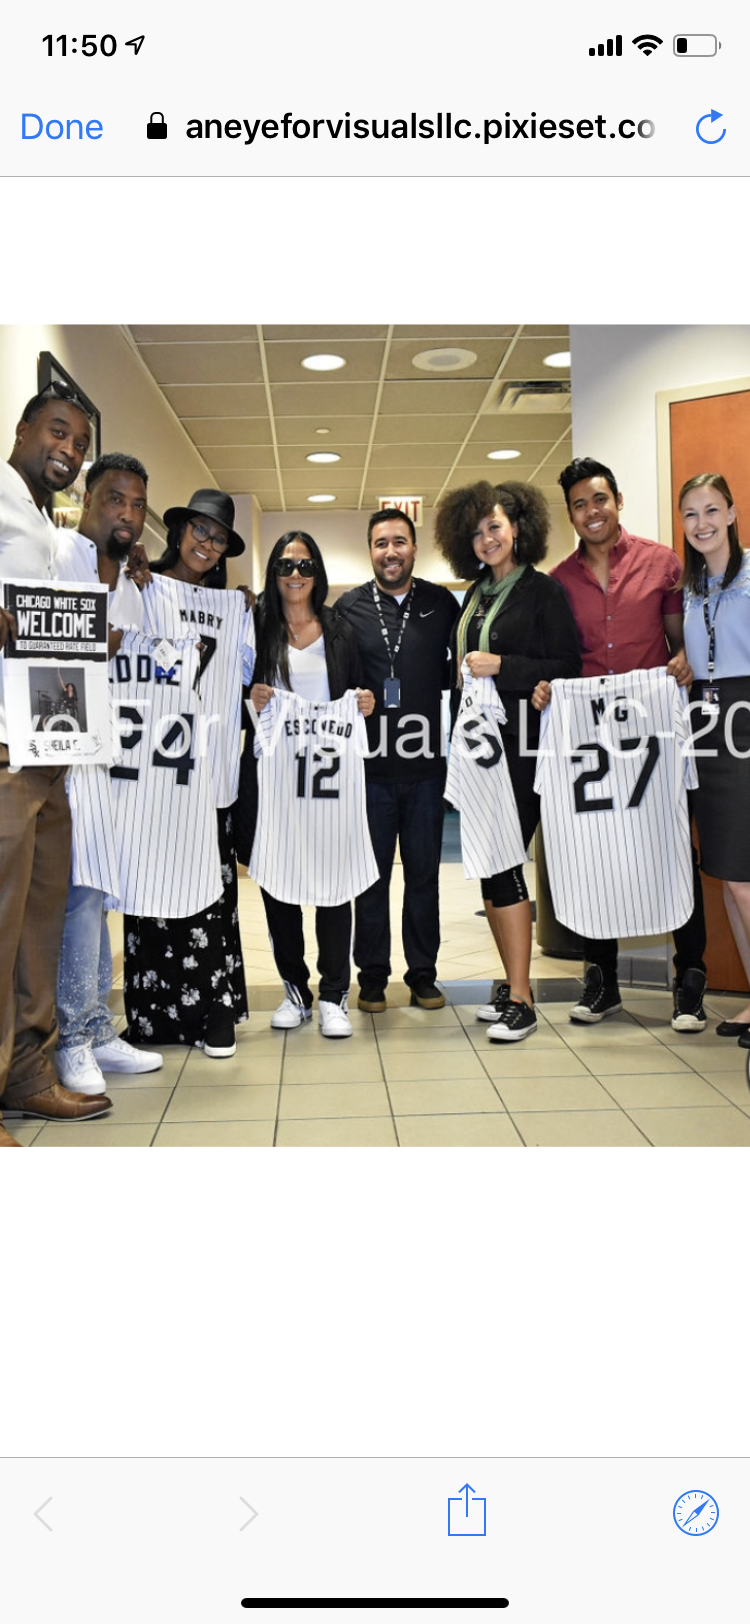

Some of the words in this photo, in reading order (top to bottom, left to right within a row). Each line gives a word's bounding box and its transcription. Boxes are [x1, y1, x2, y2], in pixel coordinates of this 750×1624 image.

[43, 34, 117, 57] 11:50
[22, 113, 103, 140] Done
[186, 112, 655, 145] aneyeforvisualsllc.pixieset.co
[16, 594, 51, 609] CHICAGO
[53, 596, 78, 611] WHITE
[80, 598, 96, 611] SOX
[17, 610, 96, 638] WELCOME
[179, 609, 223, 630] MABRY
[20, 641, 28, 650] TO
[28, 641, 65, 651] GUARANTEED
[65, 642, 79, 651] RATE
[80, 642, 96, 652] FIELD
[110, 705, 196, 786] 24
[295, 747, 341, 799] 12
[570, 735, 661, 815] 27
